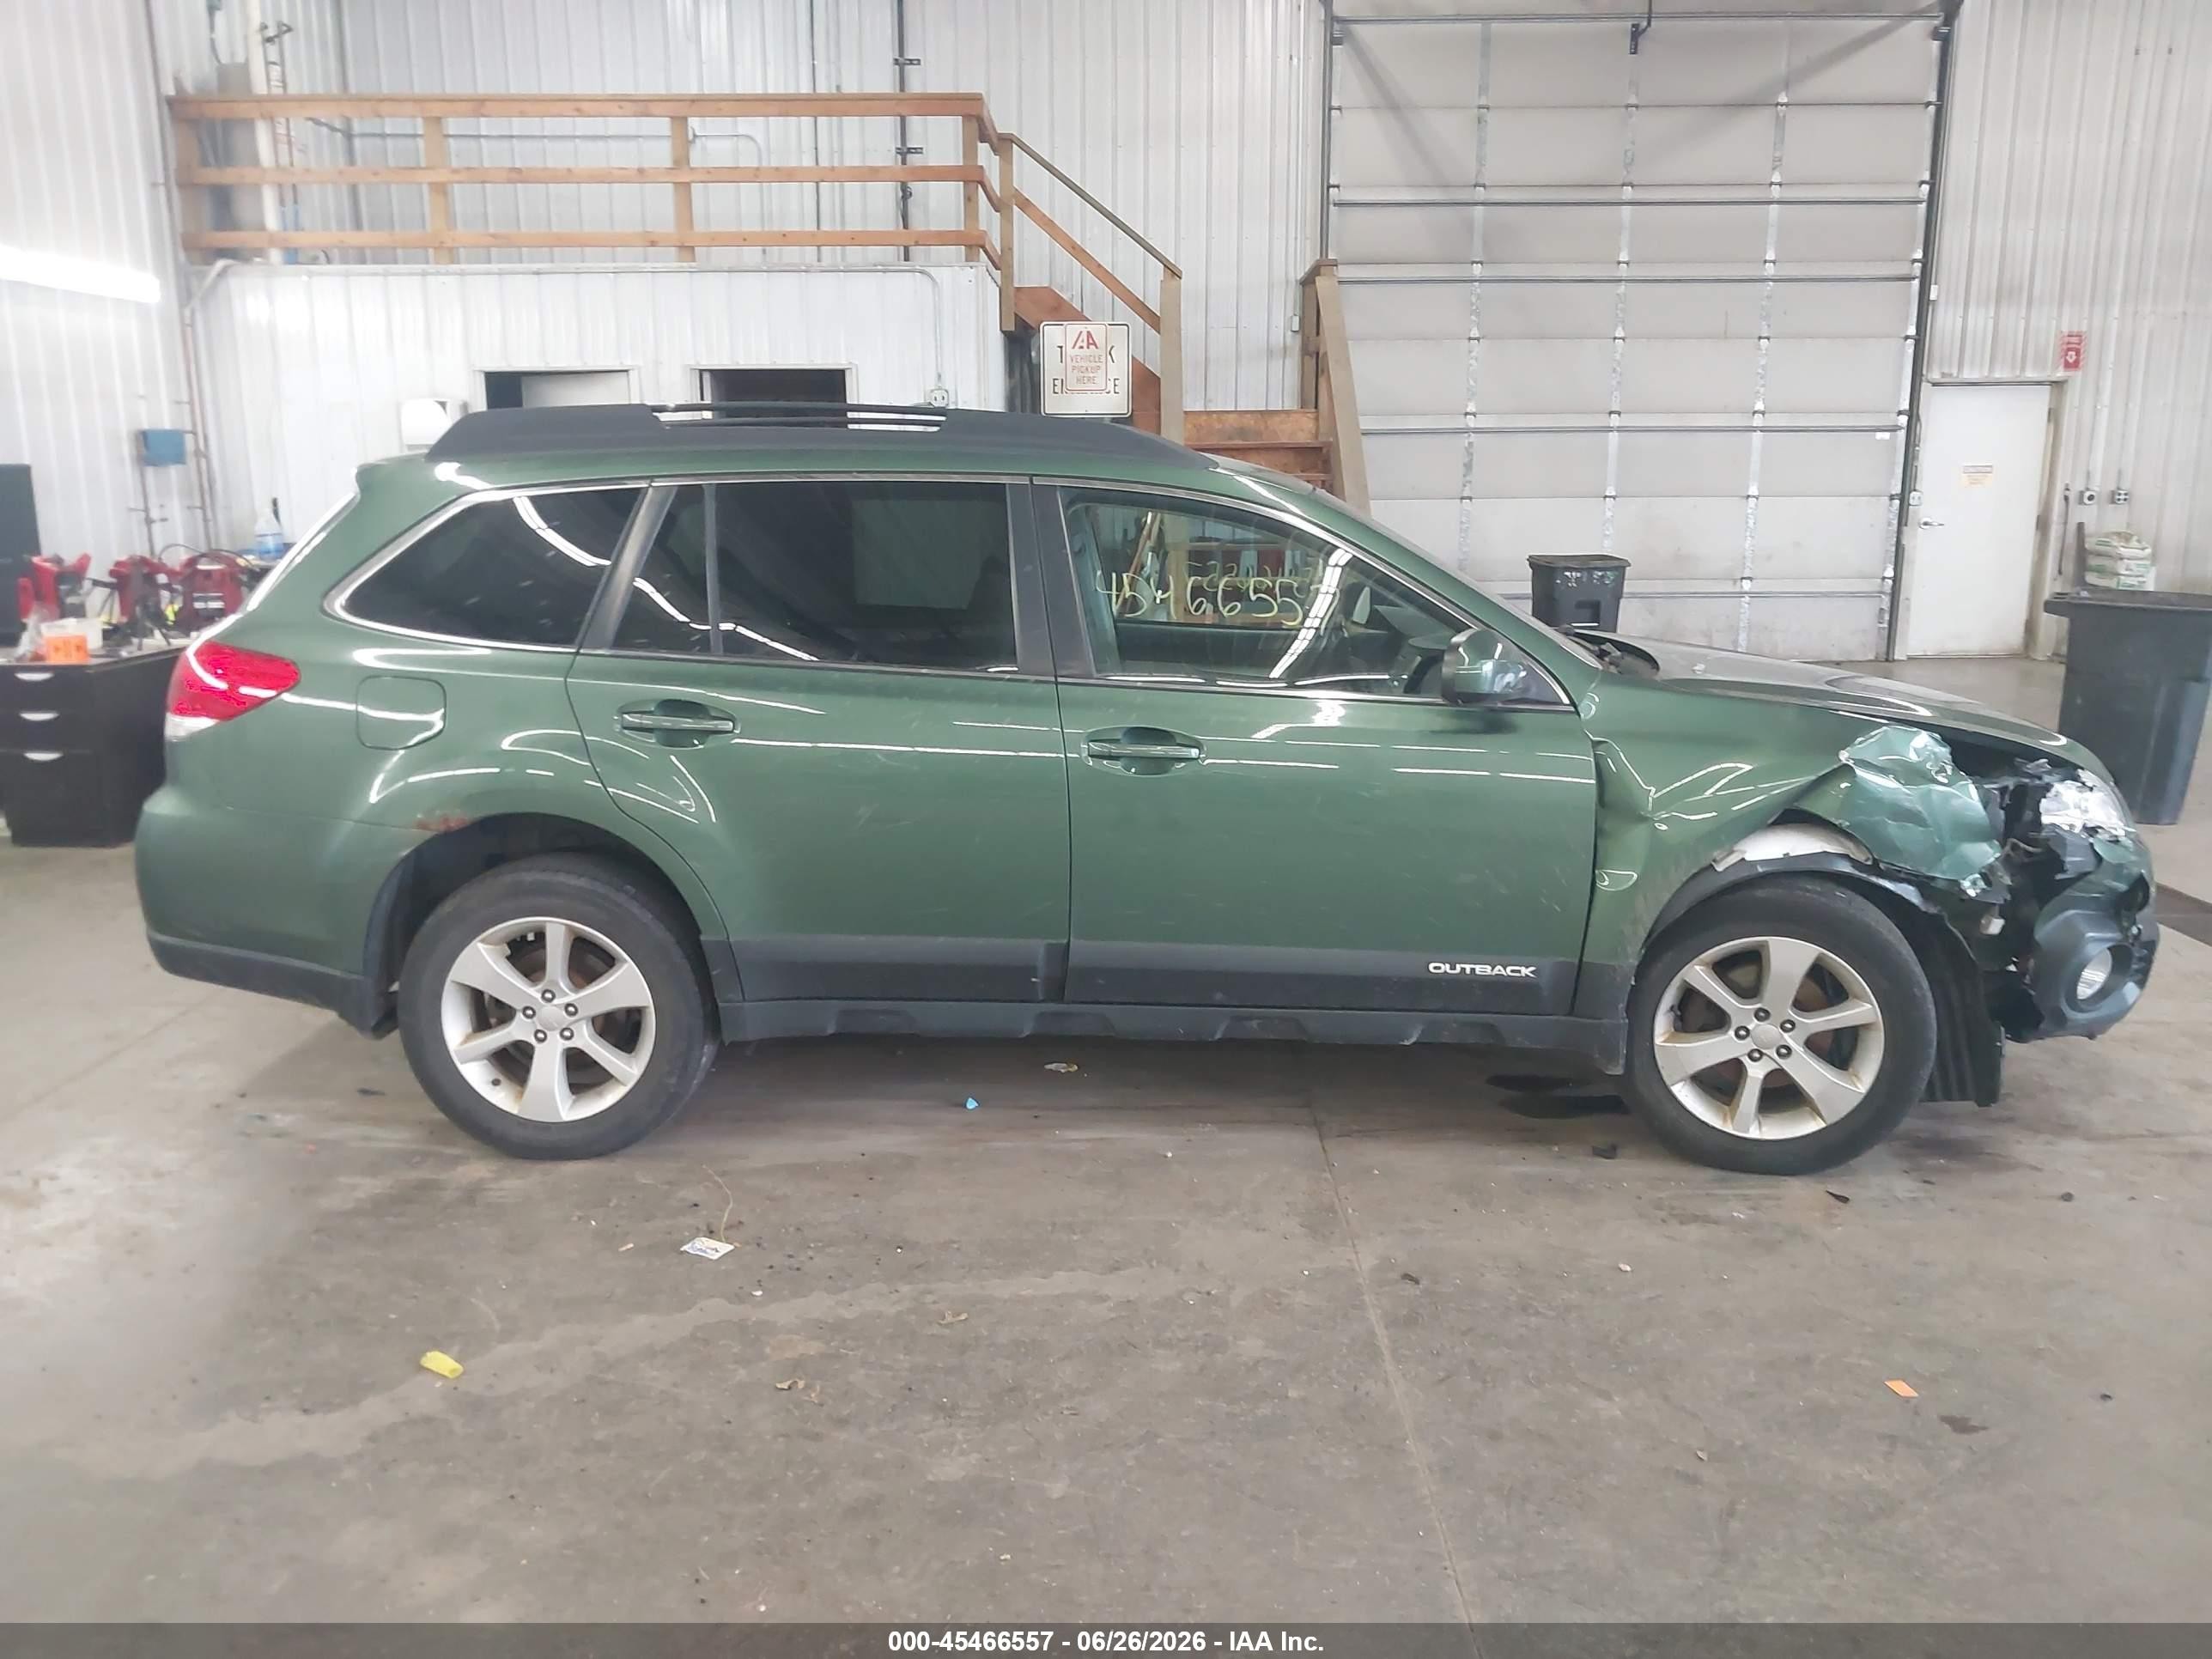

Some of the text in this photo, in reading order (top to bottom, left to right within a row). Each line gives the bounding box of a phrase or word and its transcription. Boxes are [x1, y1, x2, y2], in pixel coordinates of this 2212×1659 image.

[1070, 354, 1103, 363] VEHICLE
[1071, 365, 1101, 374] PICKUP
[1076, 375, 1097, 385] HERE
[1427, 962, 1537, 978] OUTBACK
